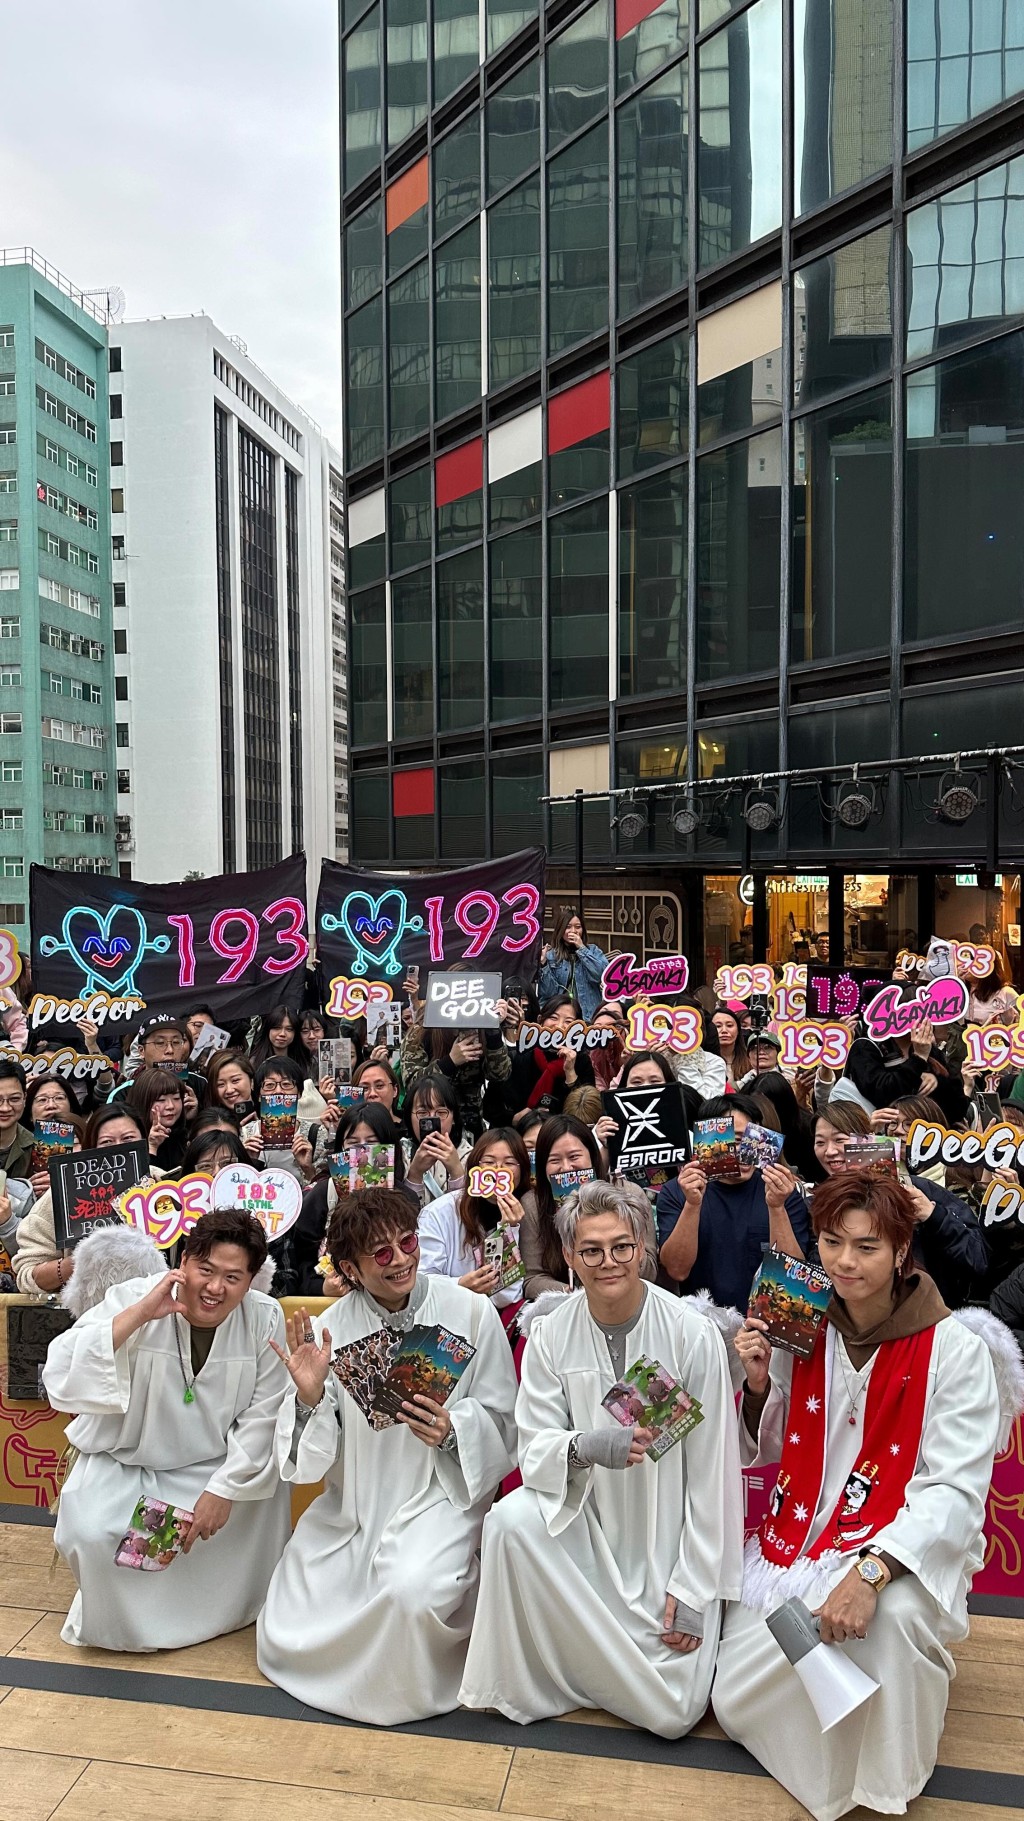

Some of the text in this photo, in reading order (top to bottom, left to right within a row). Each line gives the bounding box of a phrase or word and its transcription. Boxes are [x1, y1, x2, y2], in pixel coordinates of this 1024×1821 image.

[425, 884, 541, 962] 193
[168, 897, 310, 987] 193
[603, 957, 685, 997] SASAYAKI
[650, 960, 683, 971] ささやき
[431, 979, 485, 1001] DEE
[720, 967, 773, 998] 193
[31, 994, 142, 1030] DeeGor
[440, 998, 499, 1020] GOR
[870, 990, 962, 1036] SASAYAKI
[519, 1022, 617, 1054] DeeGor
[630, 1006, 699, 1053] 193
[782, 1026, 848, 1067] 193
[73, 1154, 127, 1176] DEAD
[75, 1168, 127, 1190] FOOT
[237, 1183, 277, 1201] 193
[470, 1170, 512, 1195] 193
[125, 1179, 211, 1242] 193
